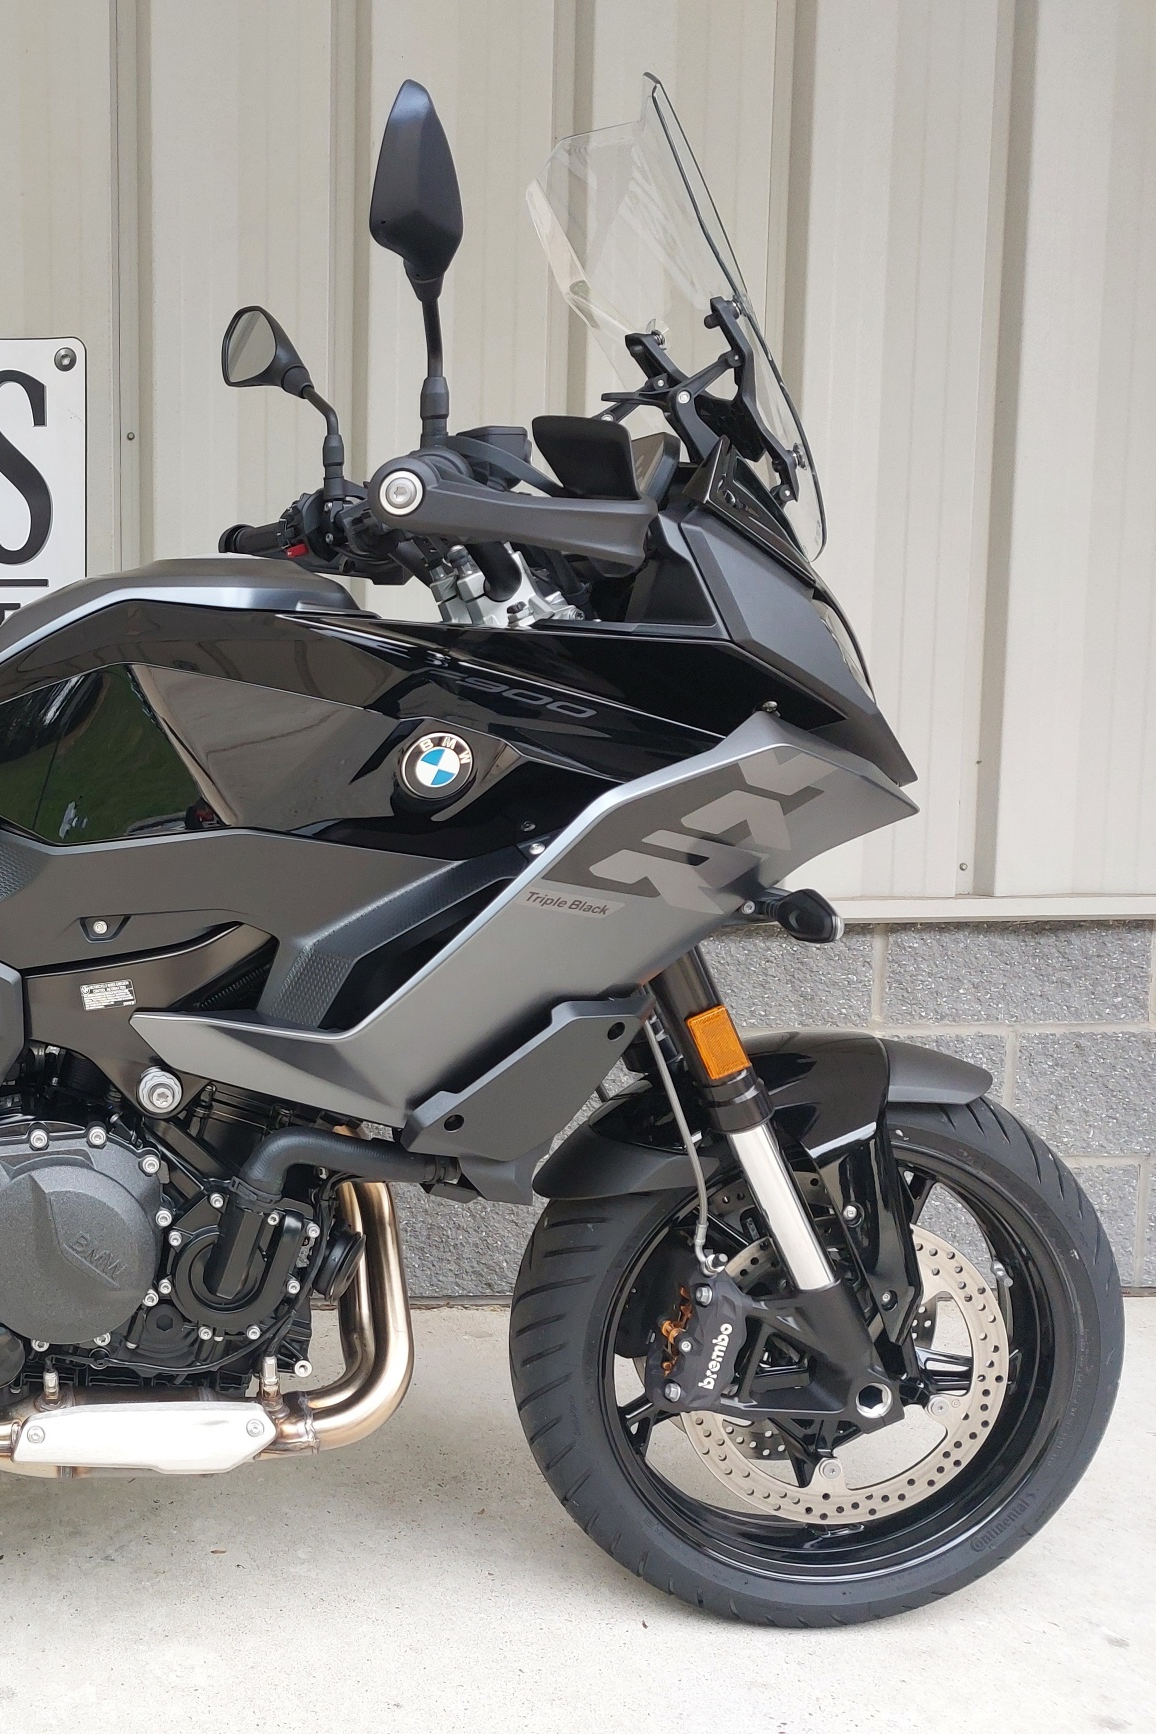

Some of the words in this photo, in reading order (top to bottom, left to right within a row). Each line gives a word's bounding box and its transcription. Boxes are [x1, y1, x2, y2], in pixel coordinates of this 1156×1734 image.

[419, 736, 472, 765] BMW
[526, 891, 568, 908] Triple
[568, 899, 610, 915] Black
[69, 1230, 128, 1280] BMW
[698, 1323, 733, 1390] brembo
